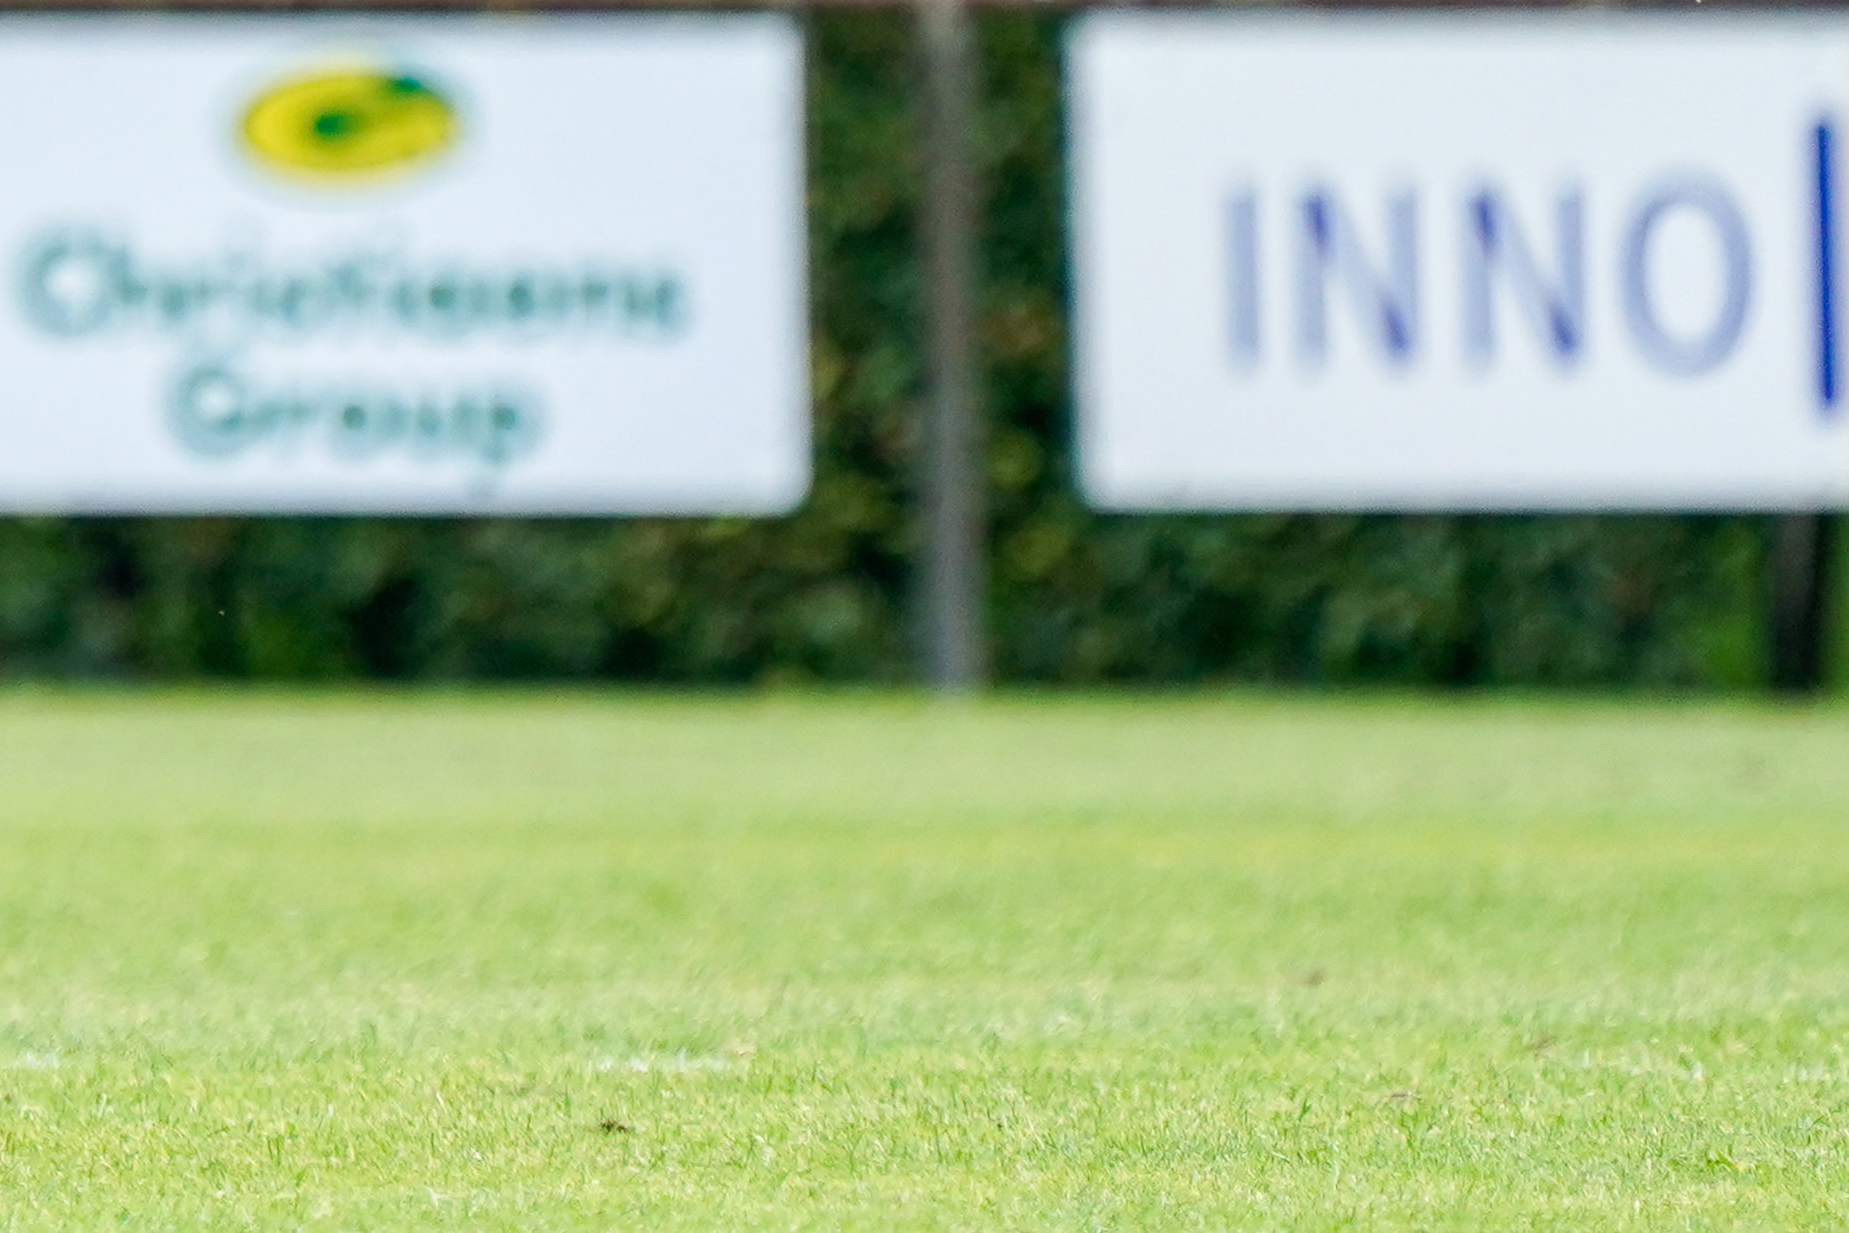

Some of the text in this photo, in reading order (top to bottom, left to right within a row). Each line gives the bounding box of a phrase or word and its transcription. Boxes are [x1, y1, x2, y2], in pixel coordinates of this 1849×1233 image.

[12, 219, 690, 337] Christiaens
[1222, 173, 1756, 376] INNO
[162, 355, 546, 492] Group
